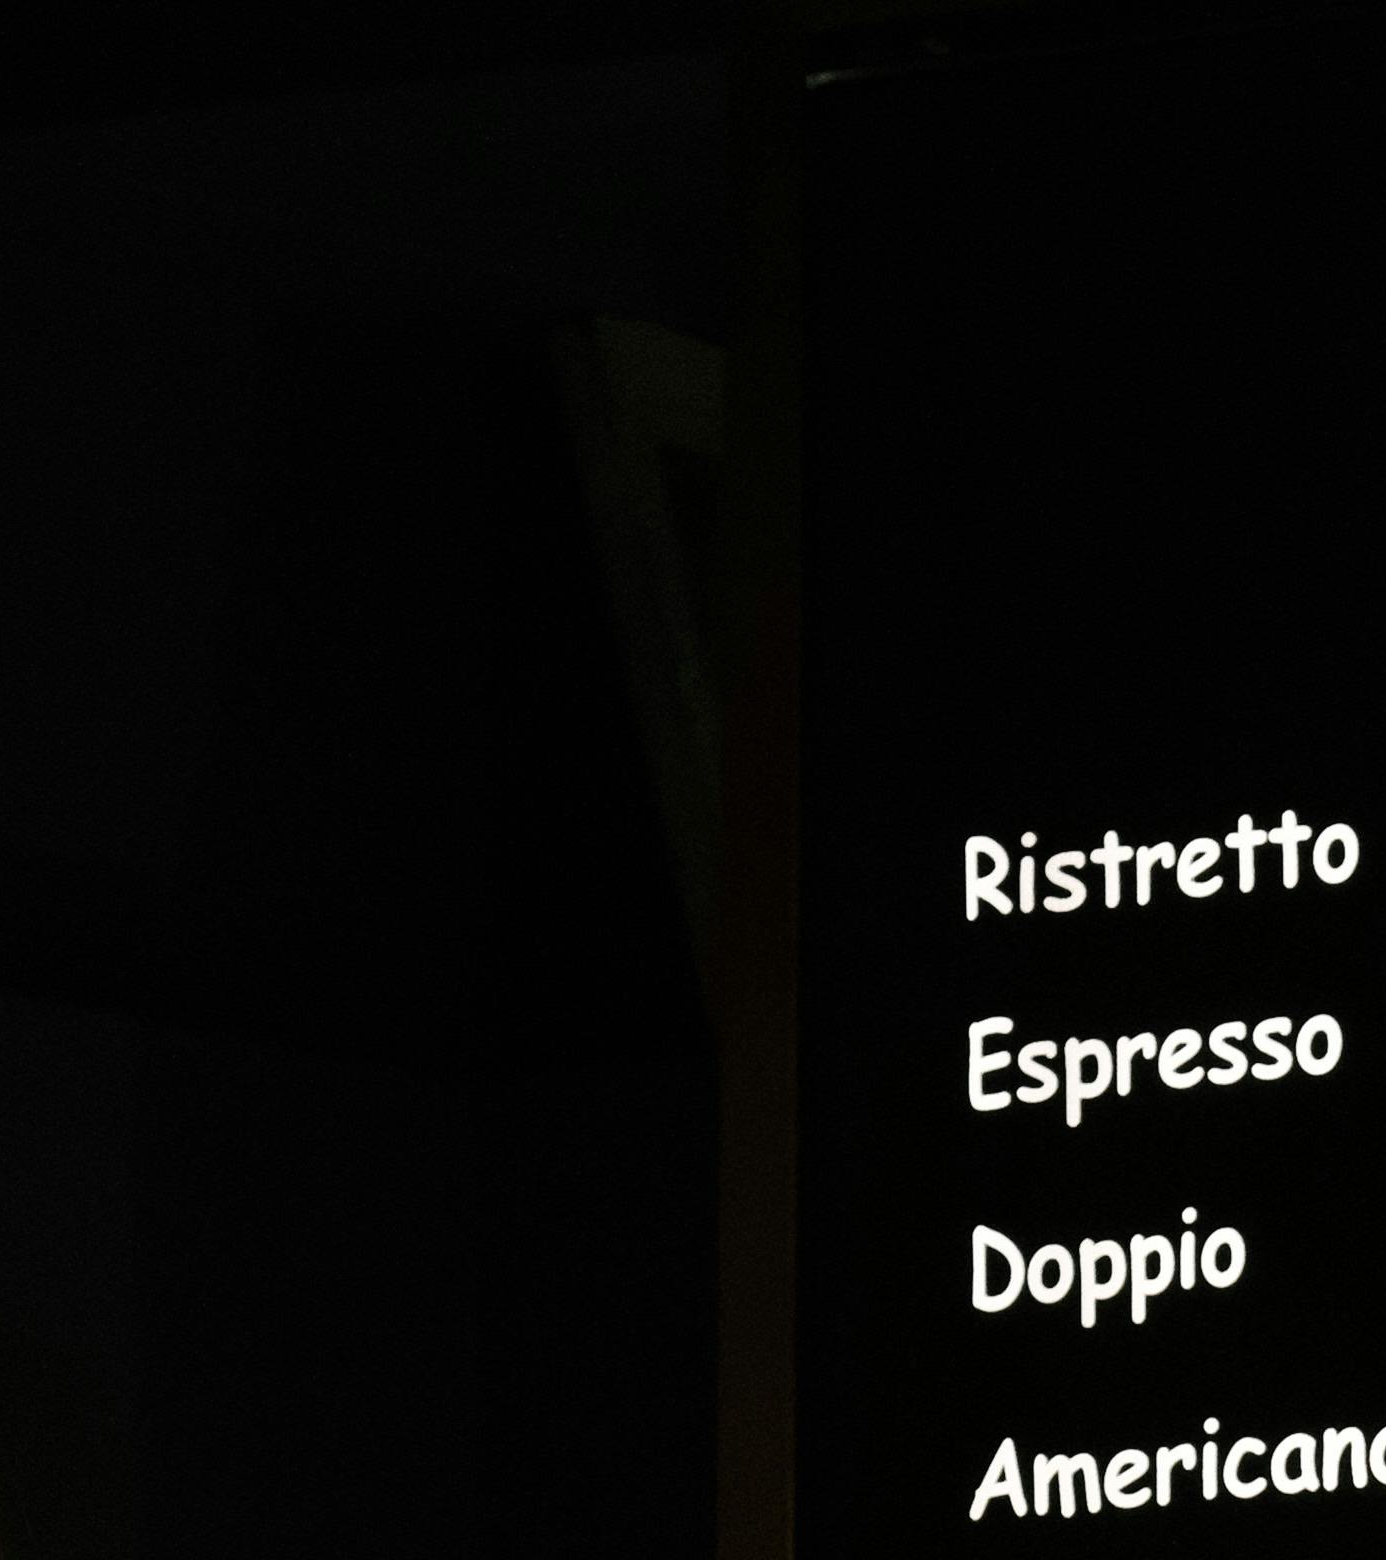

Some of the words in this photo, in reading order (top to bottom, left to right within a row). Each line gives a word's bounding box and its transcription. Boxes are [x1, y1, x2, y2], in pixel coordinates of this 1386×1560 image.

[963, 808, 1361, 923] Ristretto
[967, 1012, 1345, 1129] Espresso
[970, 1205, 1248, 1330] Doppio
